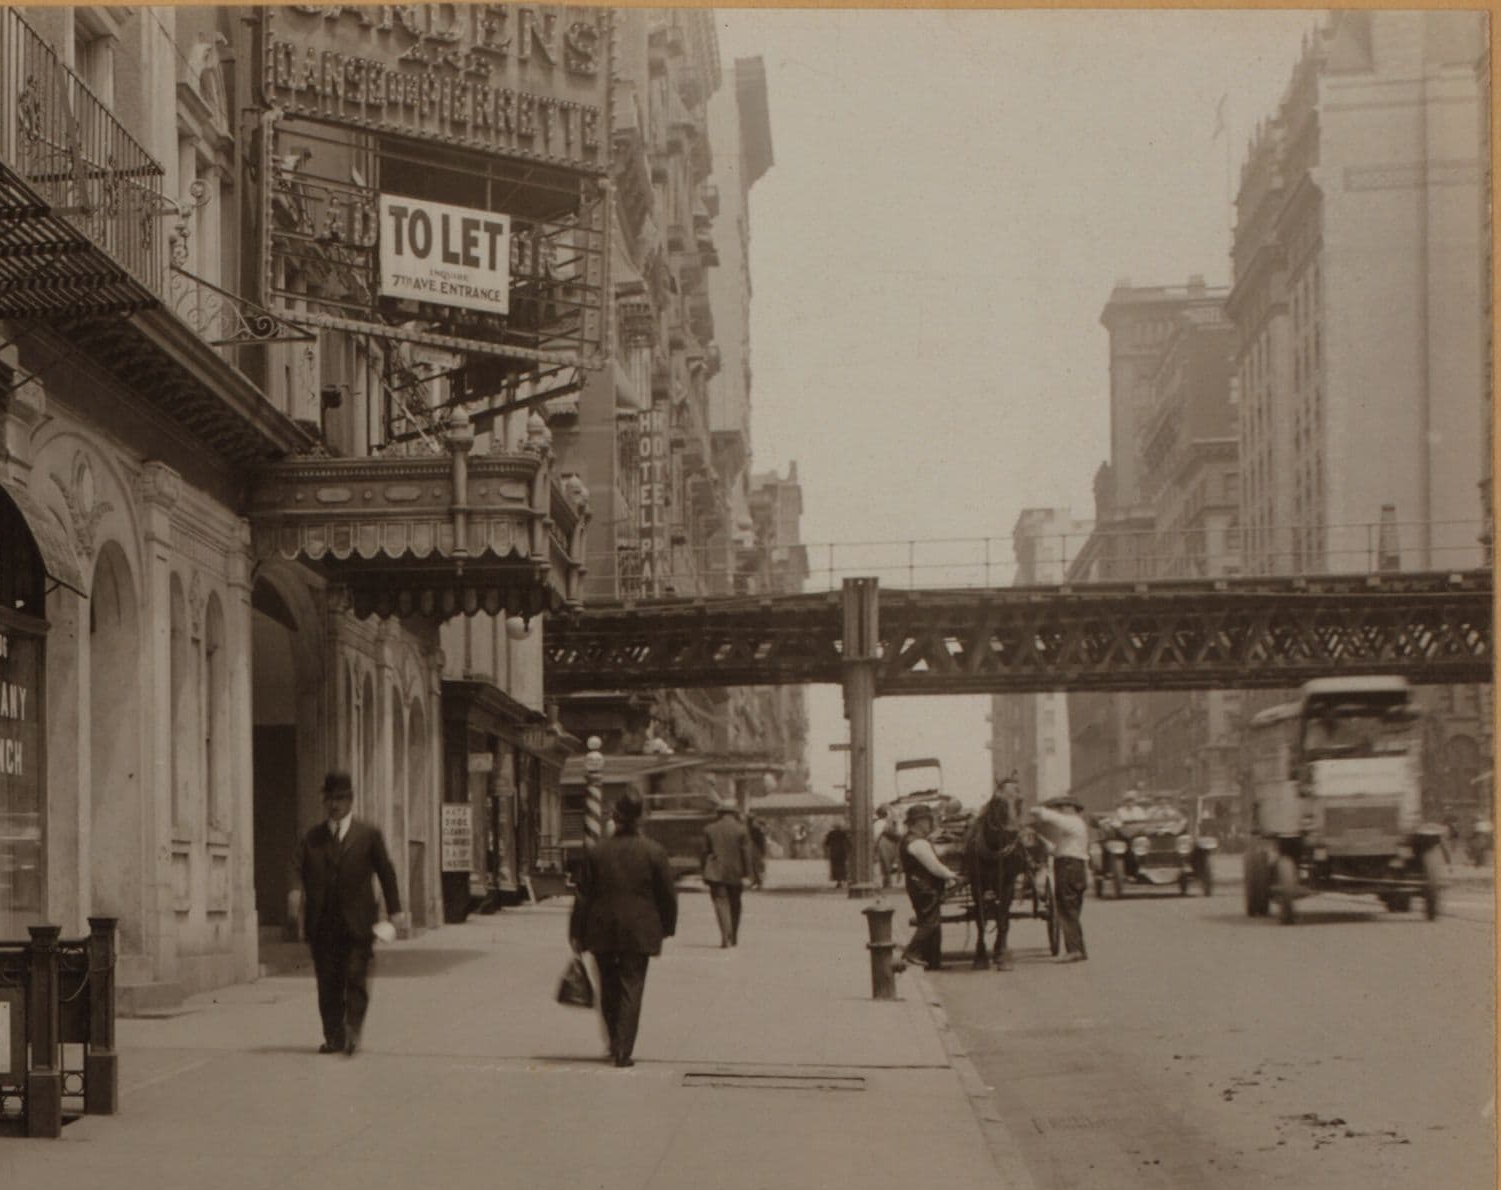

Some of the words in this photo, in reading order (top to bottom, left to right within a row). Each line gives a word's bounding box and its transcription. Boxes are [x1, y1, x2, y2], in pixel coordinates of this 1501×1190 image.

[273, 41, 386, 105] DANSE
[419, 71, 601, 147] PIERRETTE
[388, 204, 432, 260] TO
[441, 213, 503, 272] LET
[413, 277, 437, 292] AVE
[441, 282, 502, 303] ENTRANCE
[639, 412, 652, 528] HOTEL
